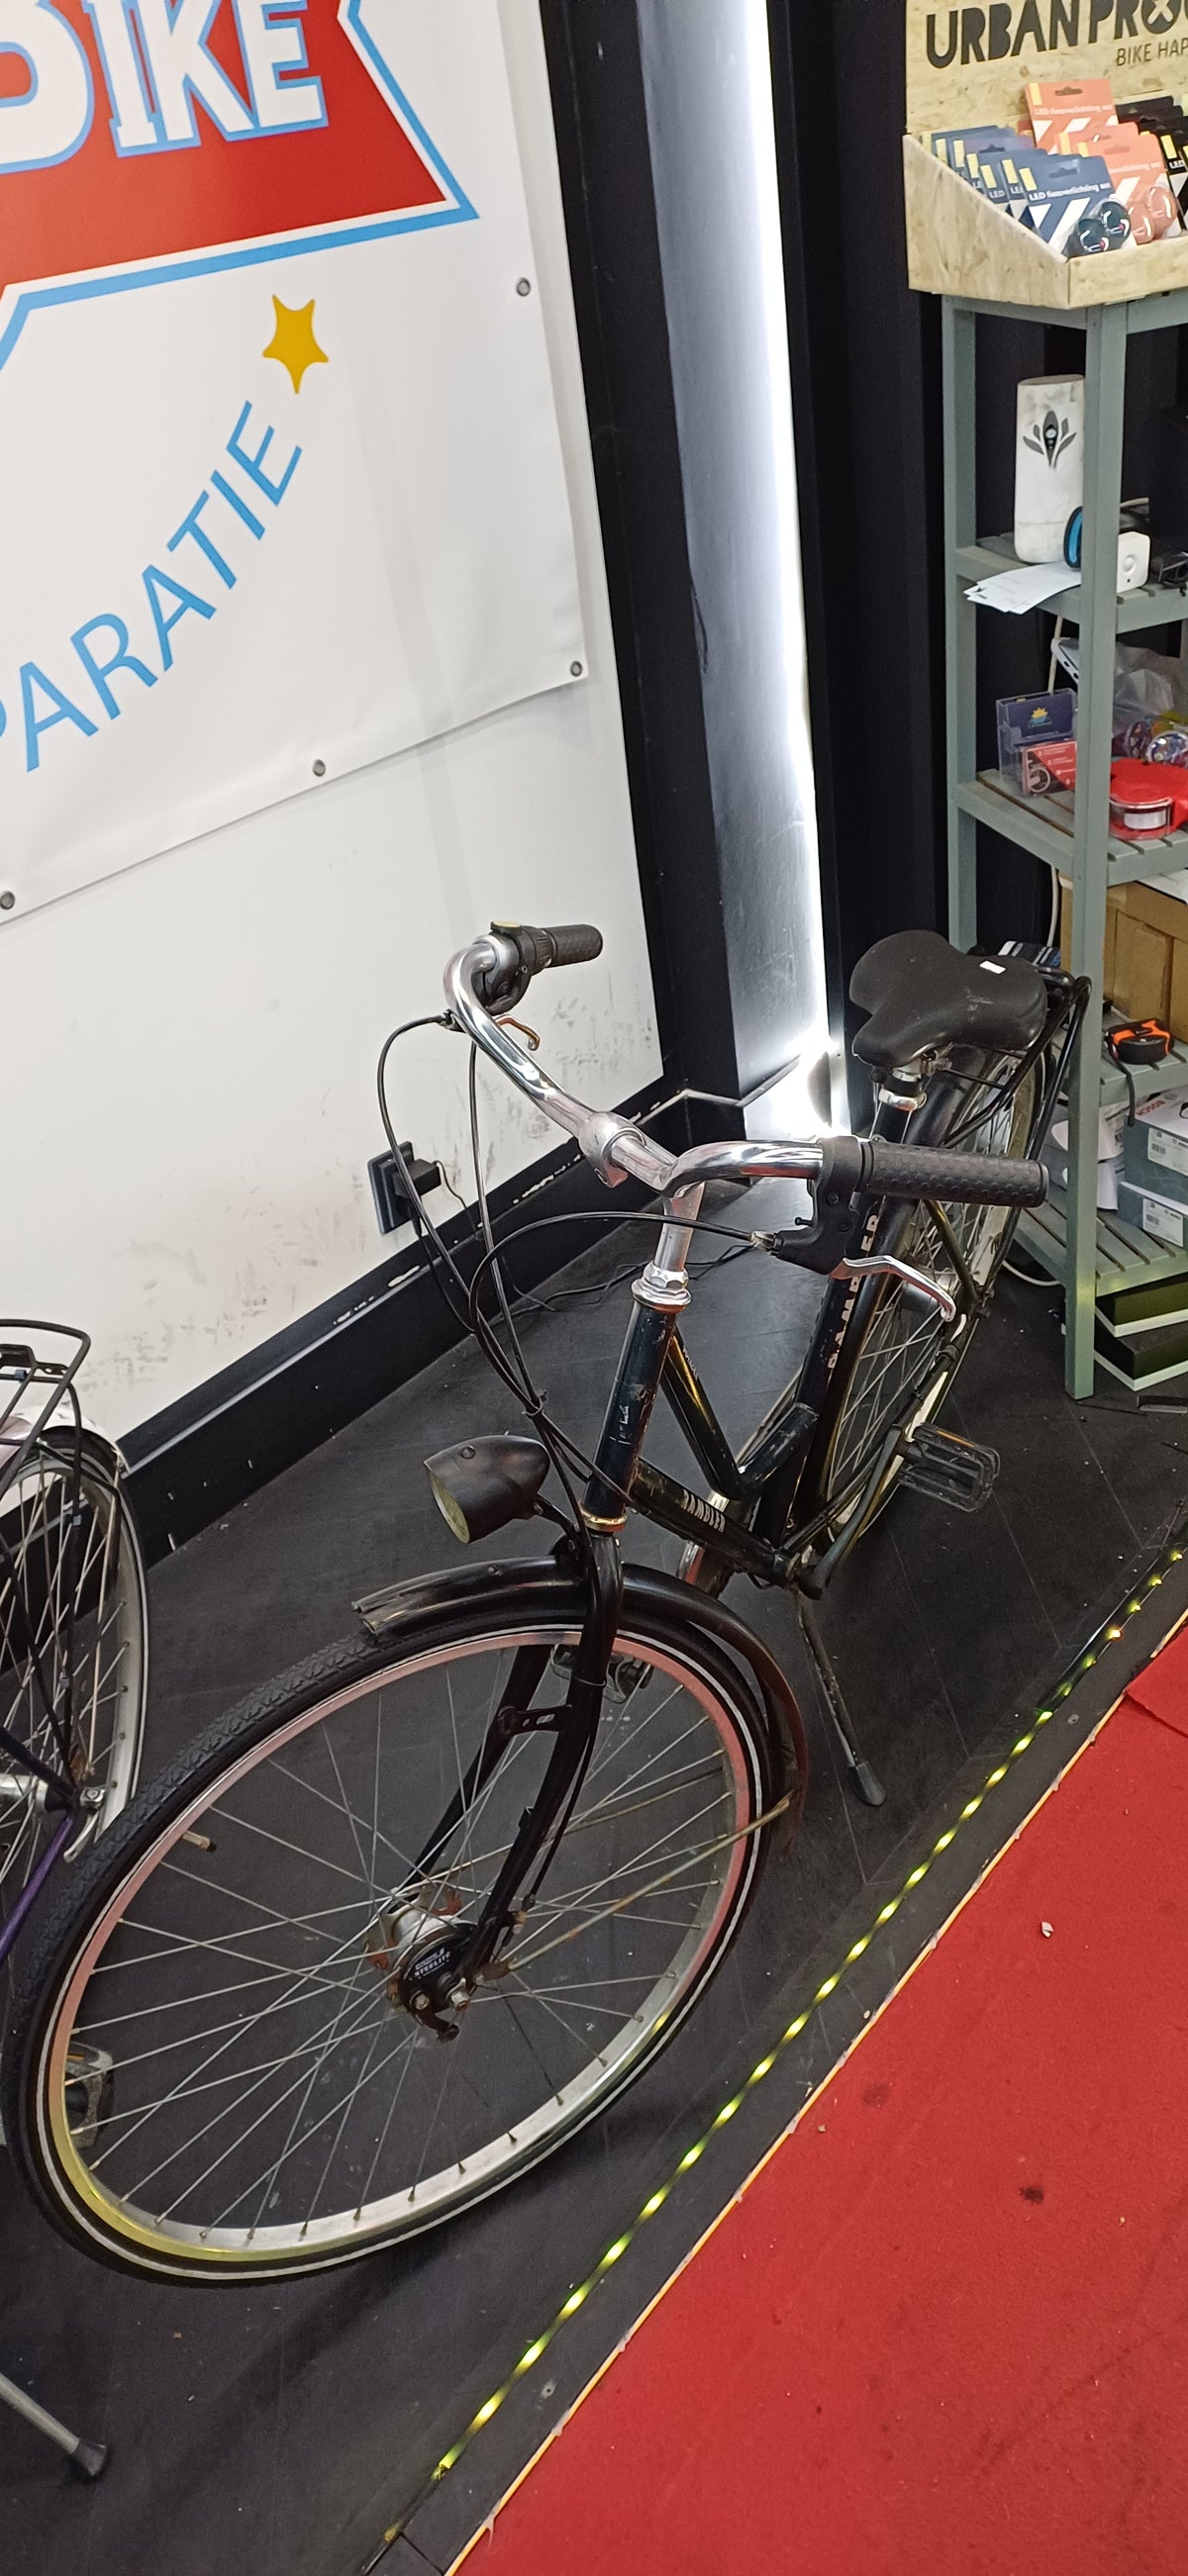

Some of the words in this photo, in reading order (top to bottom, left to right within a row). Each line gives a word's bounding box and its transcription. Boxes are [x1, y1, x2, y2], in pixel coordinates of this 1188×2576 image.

[926, 0, 1078, 68] URBAN
[1088, 0, 1188, 45] PRO
[1116, 43, 1151, 66] BIKE
[1168, 160, 1185, 169] LED
[988, 189, 1005, 198] LED
[1028, 191, 1046, 201] LED
[0, 401, 302, 772] ARATIE
[680, 1488, 726, 1533] RAMBLER
